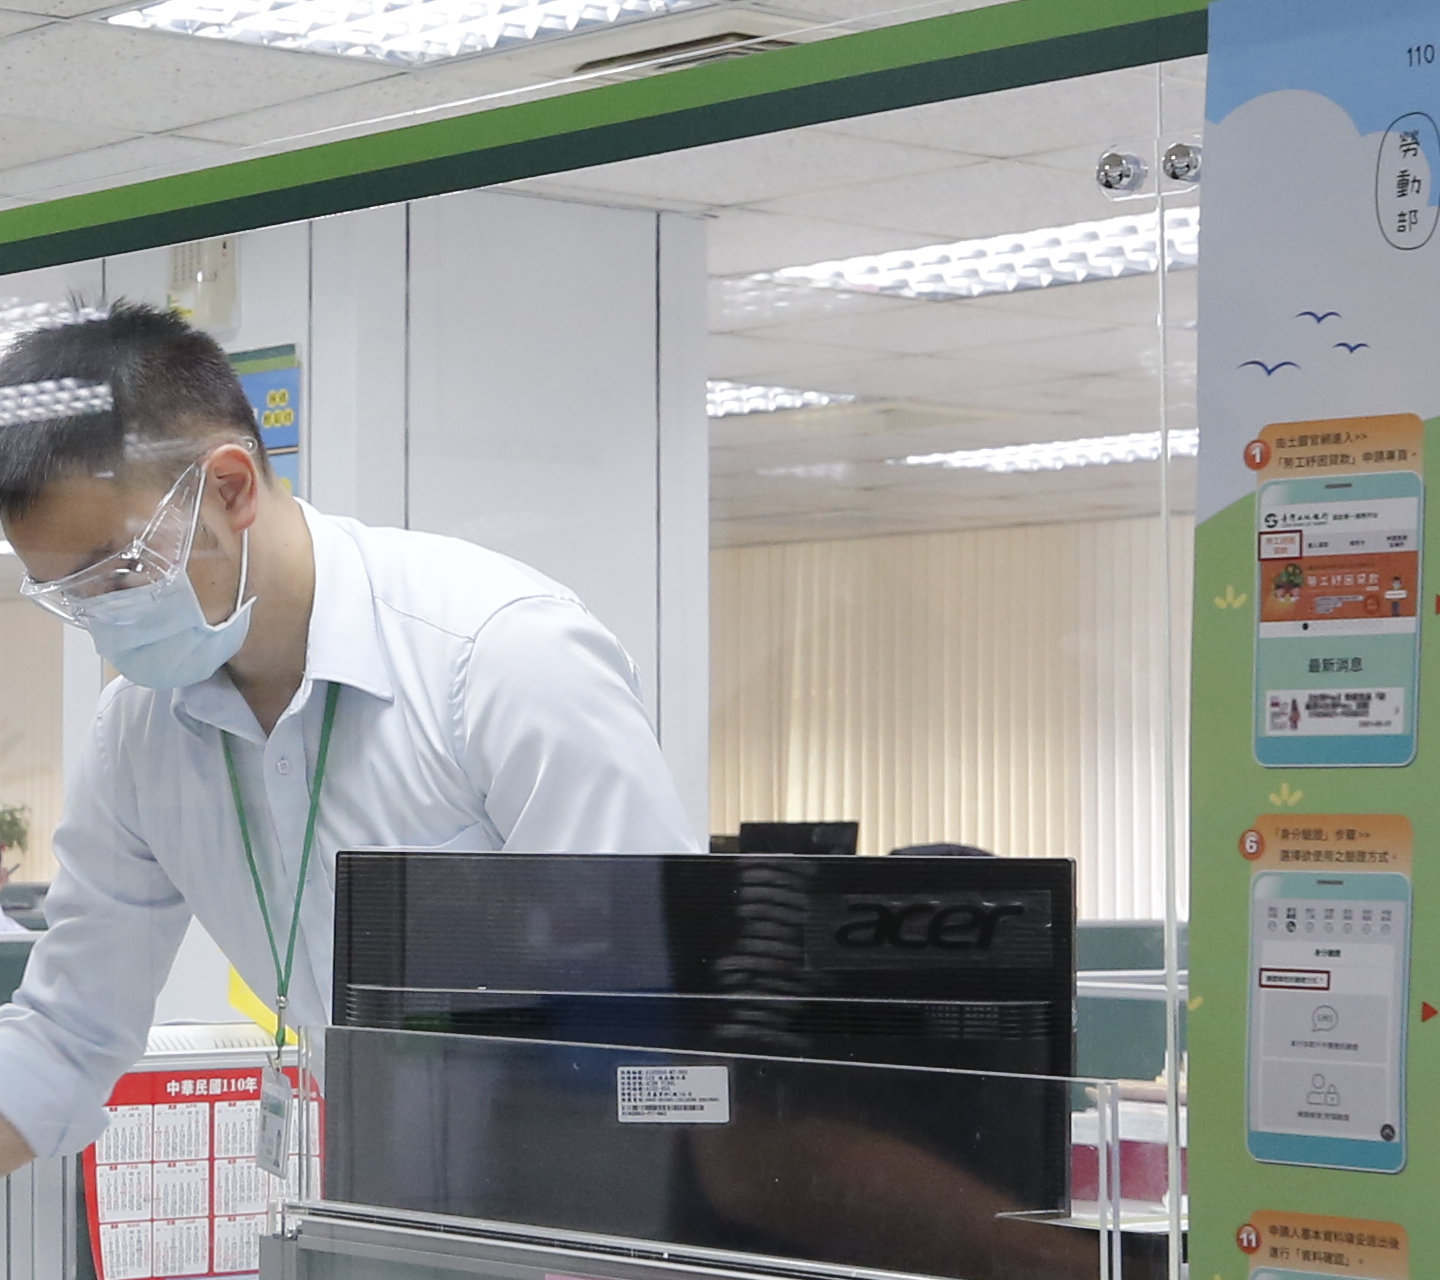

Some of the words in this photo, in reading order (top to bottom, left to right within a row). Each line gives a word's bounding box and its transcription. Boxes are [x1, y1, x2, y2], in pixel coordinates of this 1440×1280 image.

[1396, 129, 1423, 236] 勞動部
[834, 894, 1025, 952] acer
[166, 1076, 258, 1096] 中華民國110年
